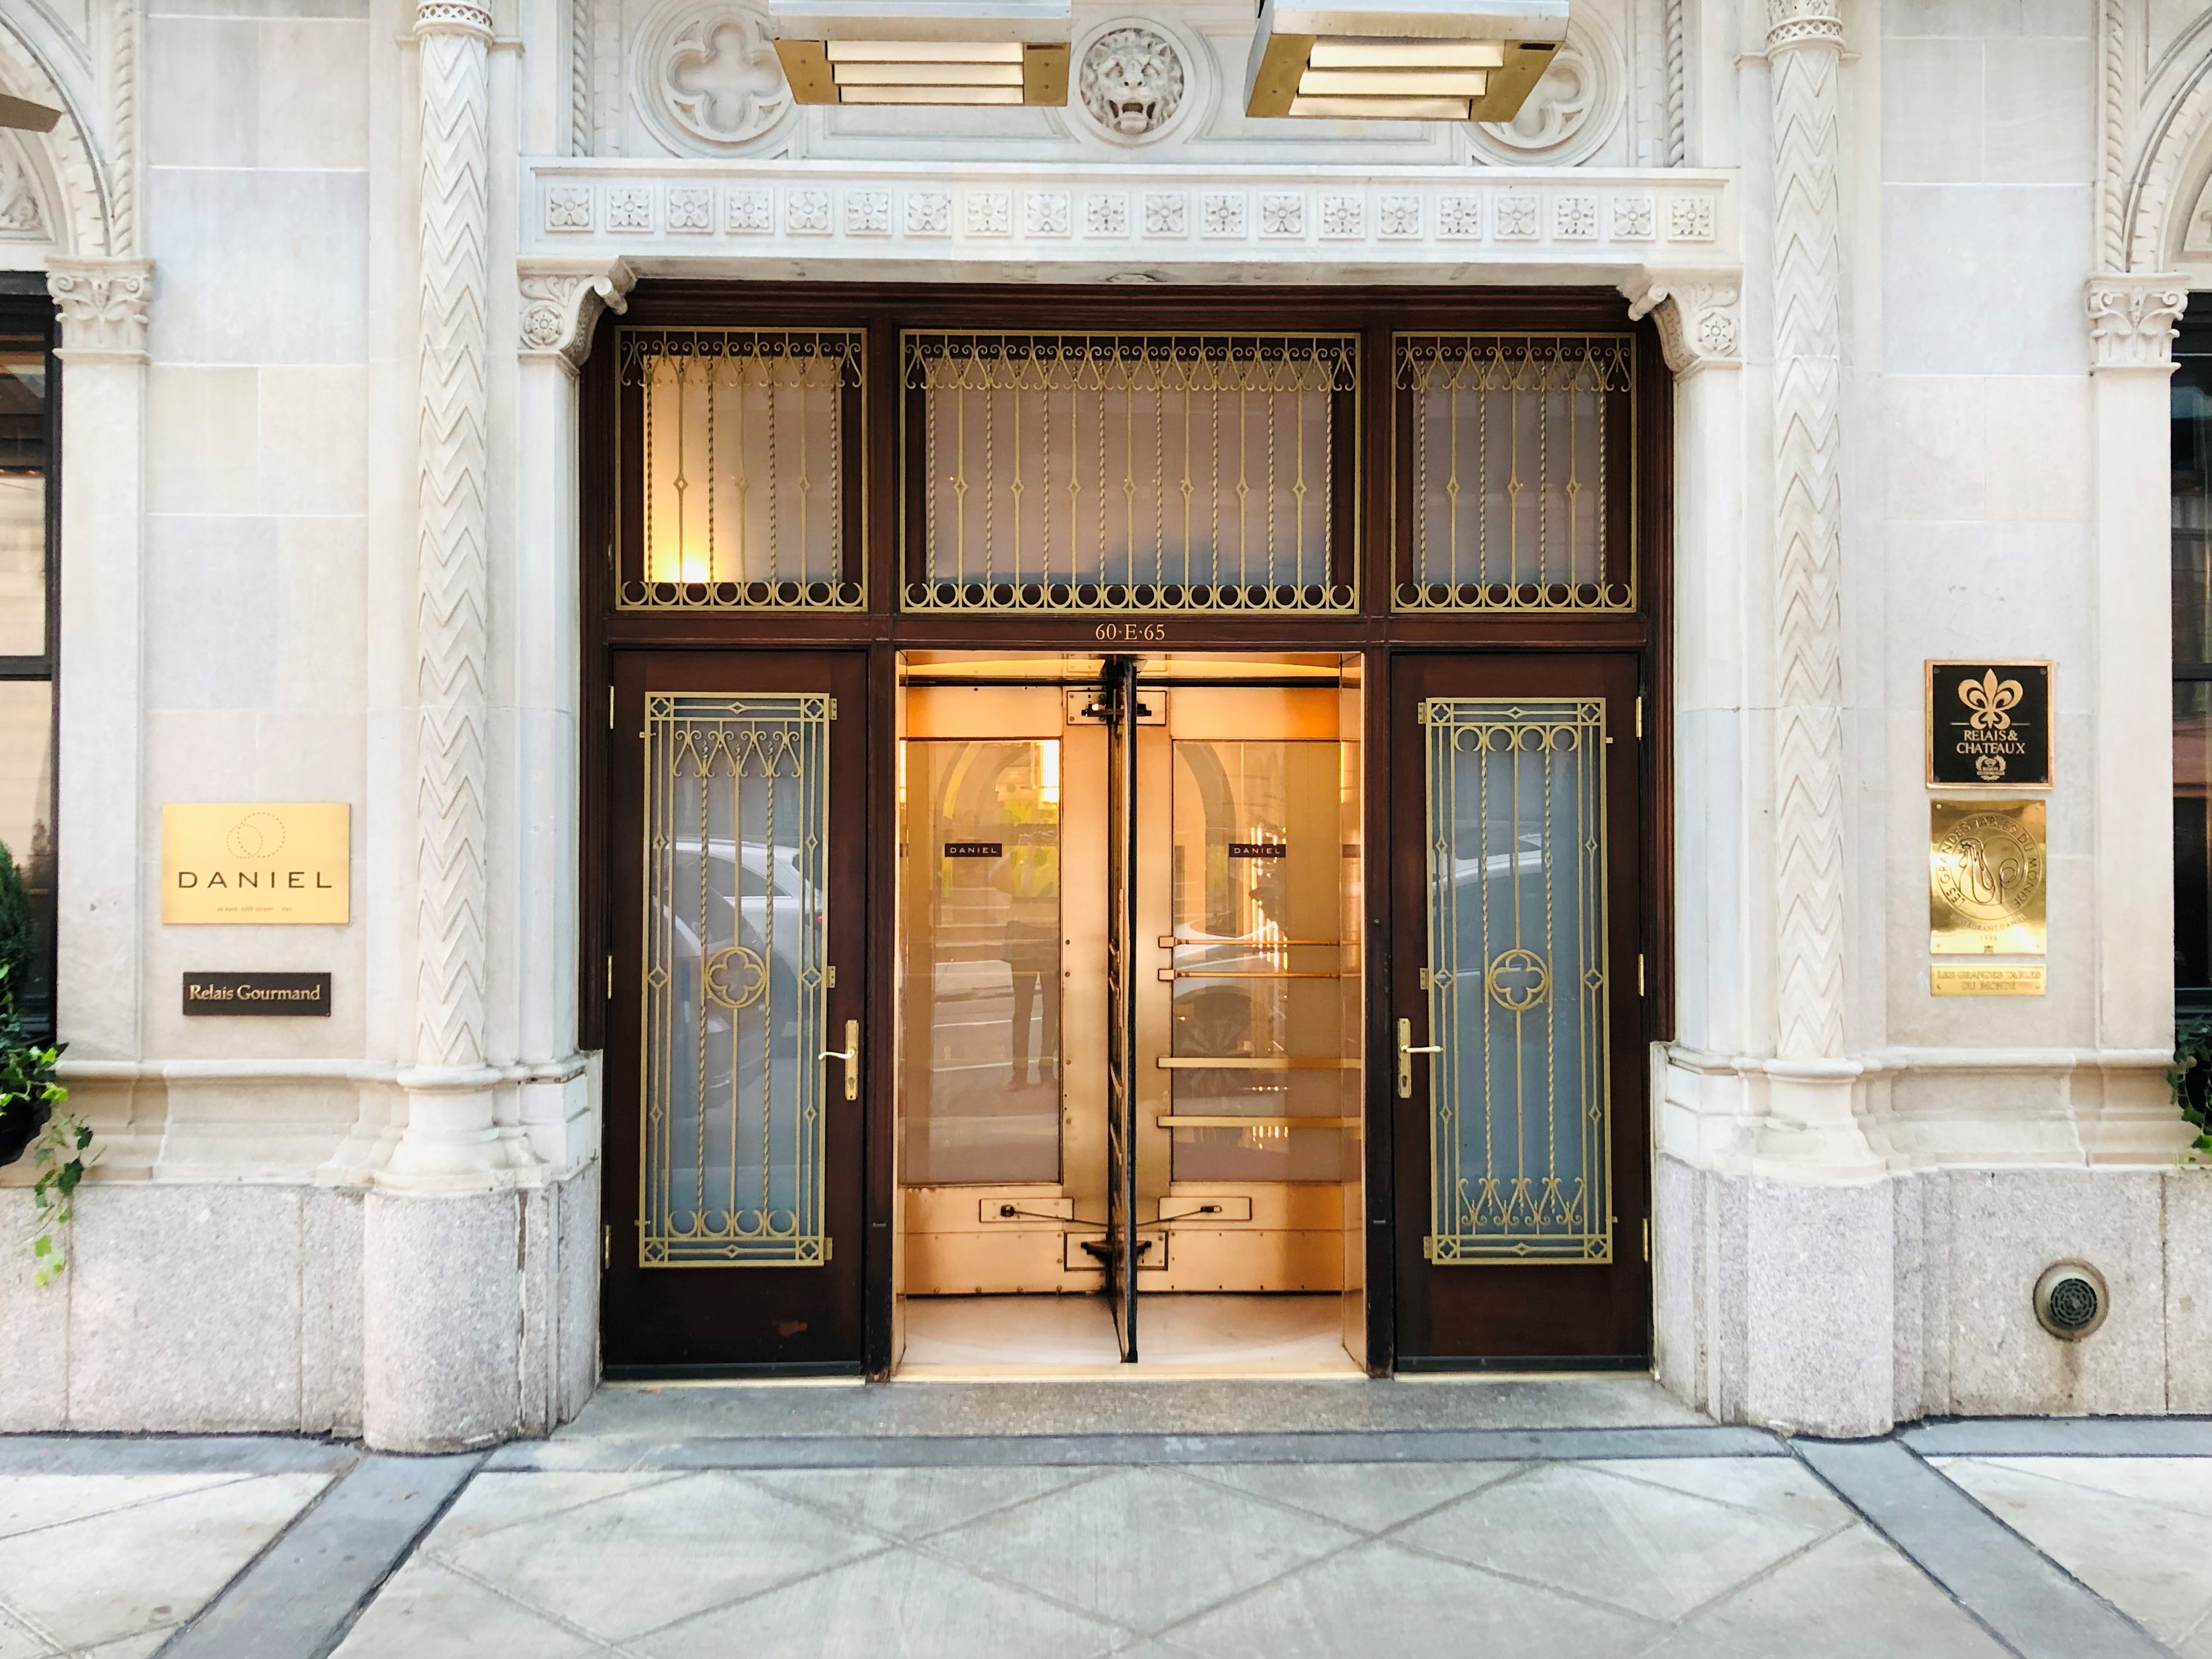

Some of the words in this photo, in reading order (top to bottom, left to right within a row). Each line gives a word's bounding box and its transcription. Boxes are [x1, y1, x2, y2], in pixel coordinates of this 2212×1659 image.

[1974, 816, 2018, 834] TABLES
[2017, 833, 2034, 851] DU
[1939, 822, 1971, 883] GRANDES
[178, 872, 332, 889] DANIEL
[2014, 857, 2038, 909] MONDE
[1946, 888, 1965, 907] LES
[2000, 913, 2027, 930] DANIEL
[1937, 970, 1955, 979] LES
[1957, 970, 2003, 979] GRANDES
[189, 984, 234, 1001] Relais
[236, 984, 321, 1001] Gourmand
[1961, 981, 1976, 990] DU
[1980, 981, 2017, 990] MONDE
